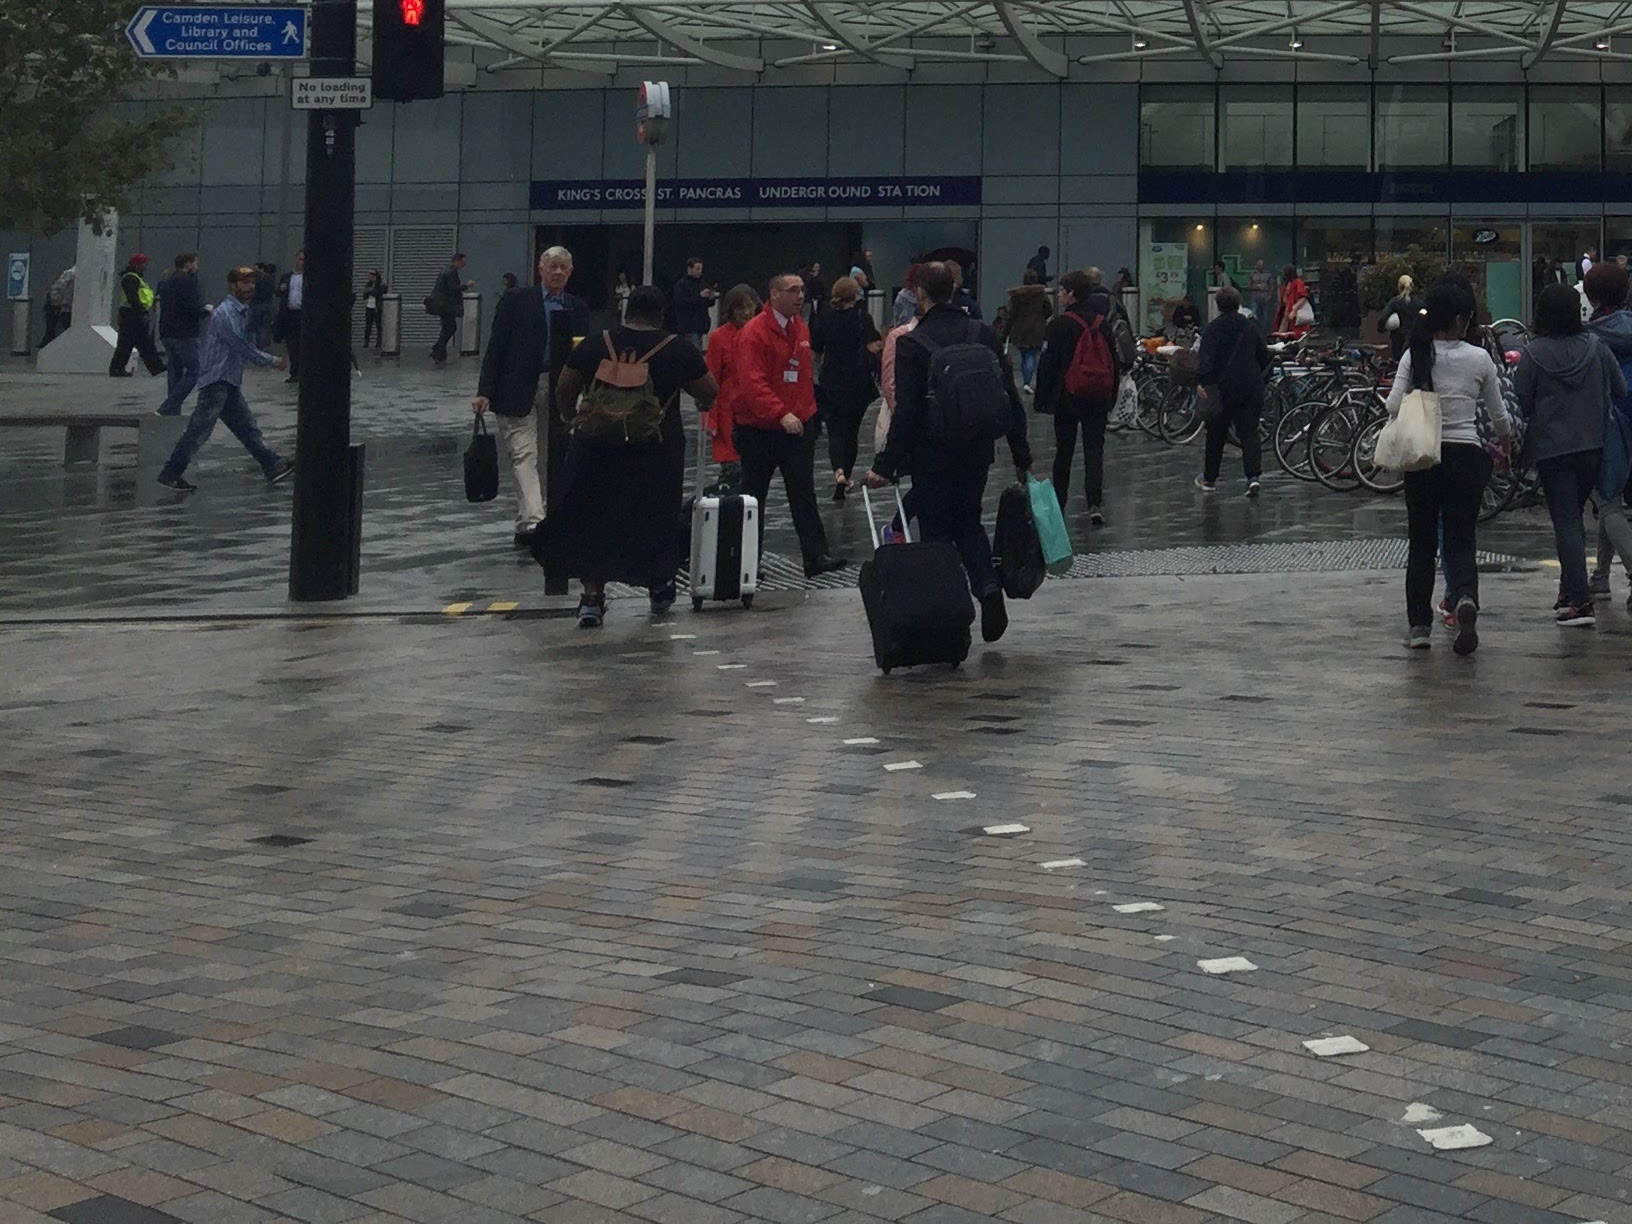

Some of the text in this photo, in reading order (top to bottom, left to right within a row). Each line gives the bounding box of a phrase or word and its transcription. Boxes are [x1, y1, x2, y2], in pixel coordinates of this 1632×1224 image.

[161, 12, 219, 24] Camden
[180, 26, 259, 39] Library and
[165, 38, 273, 51] Council Offices
[298, 82, 366, 95] No loading
[296, 93, 367, 107] at any time
[557, 188, 601, 201] KING'S
[605, 188, 647, 200] CROSS
[679, 186, 742, 199] PANCRAS
[759, 186, 871, 198] UNDERGROUND
[877, 184, 942, 197] STATION
